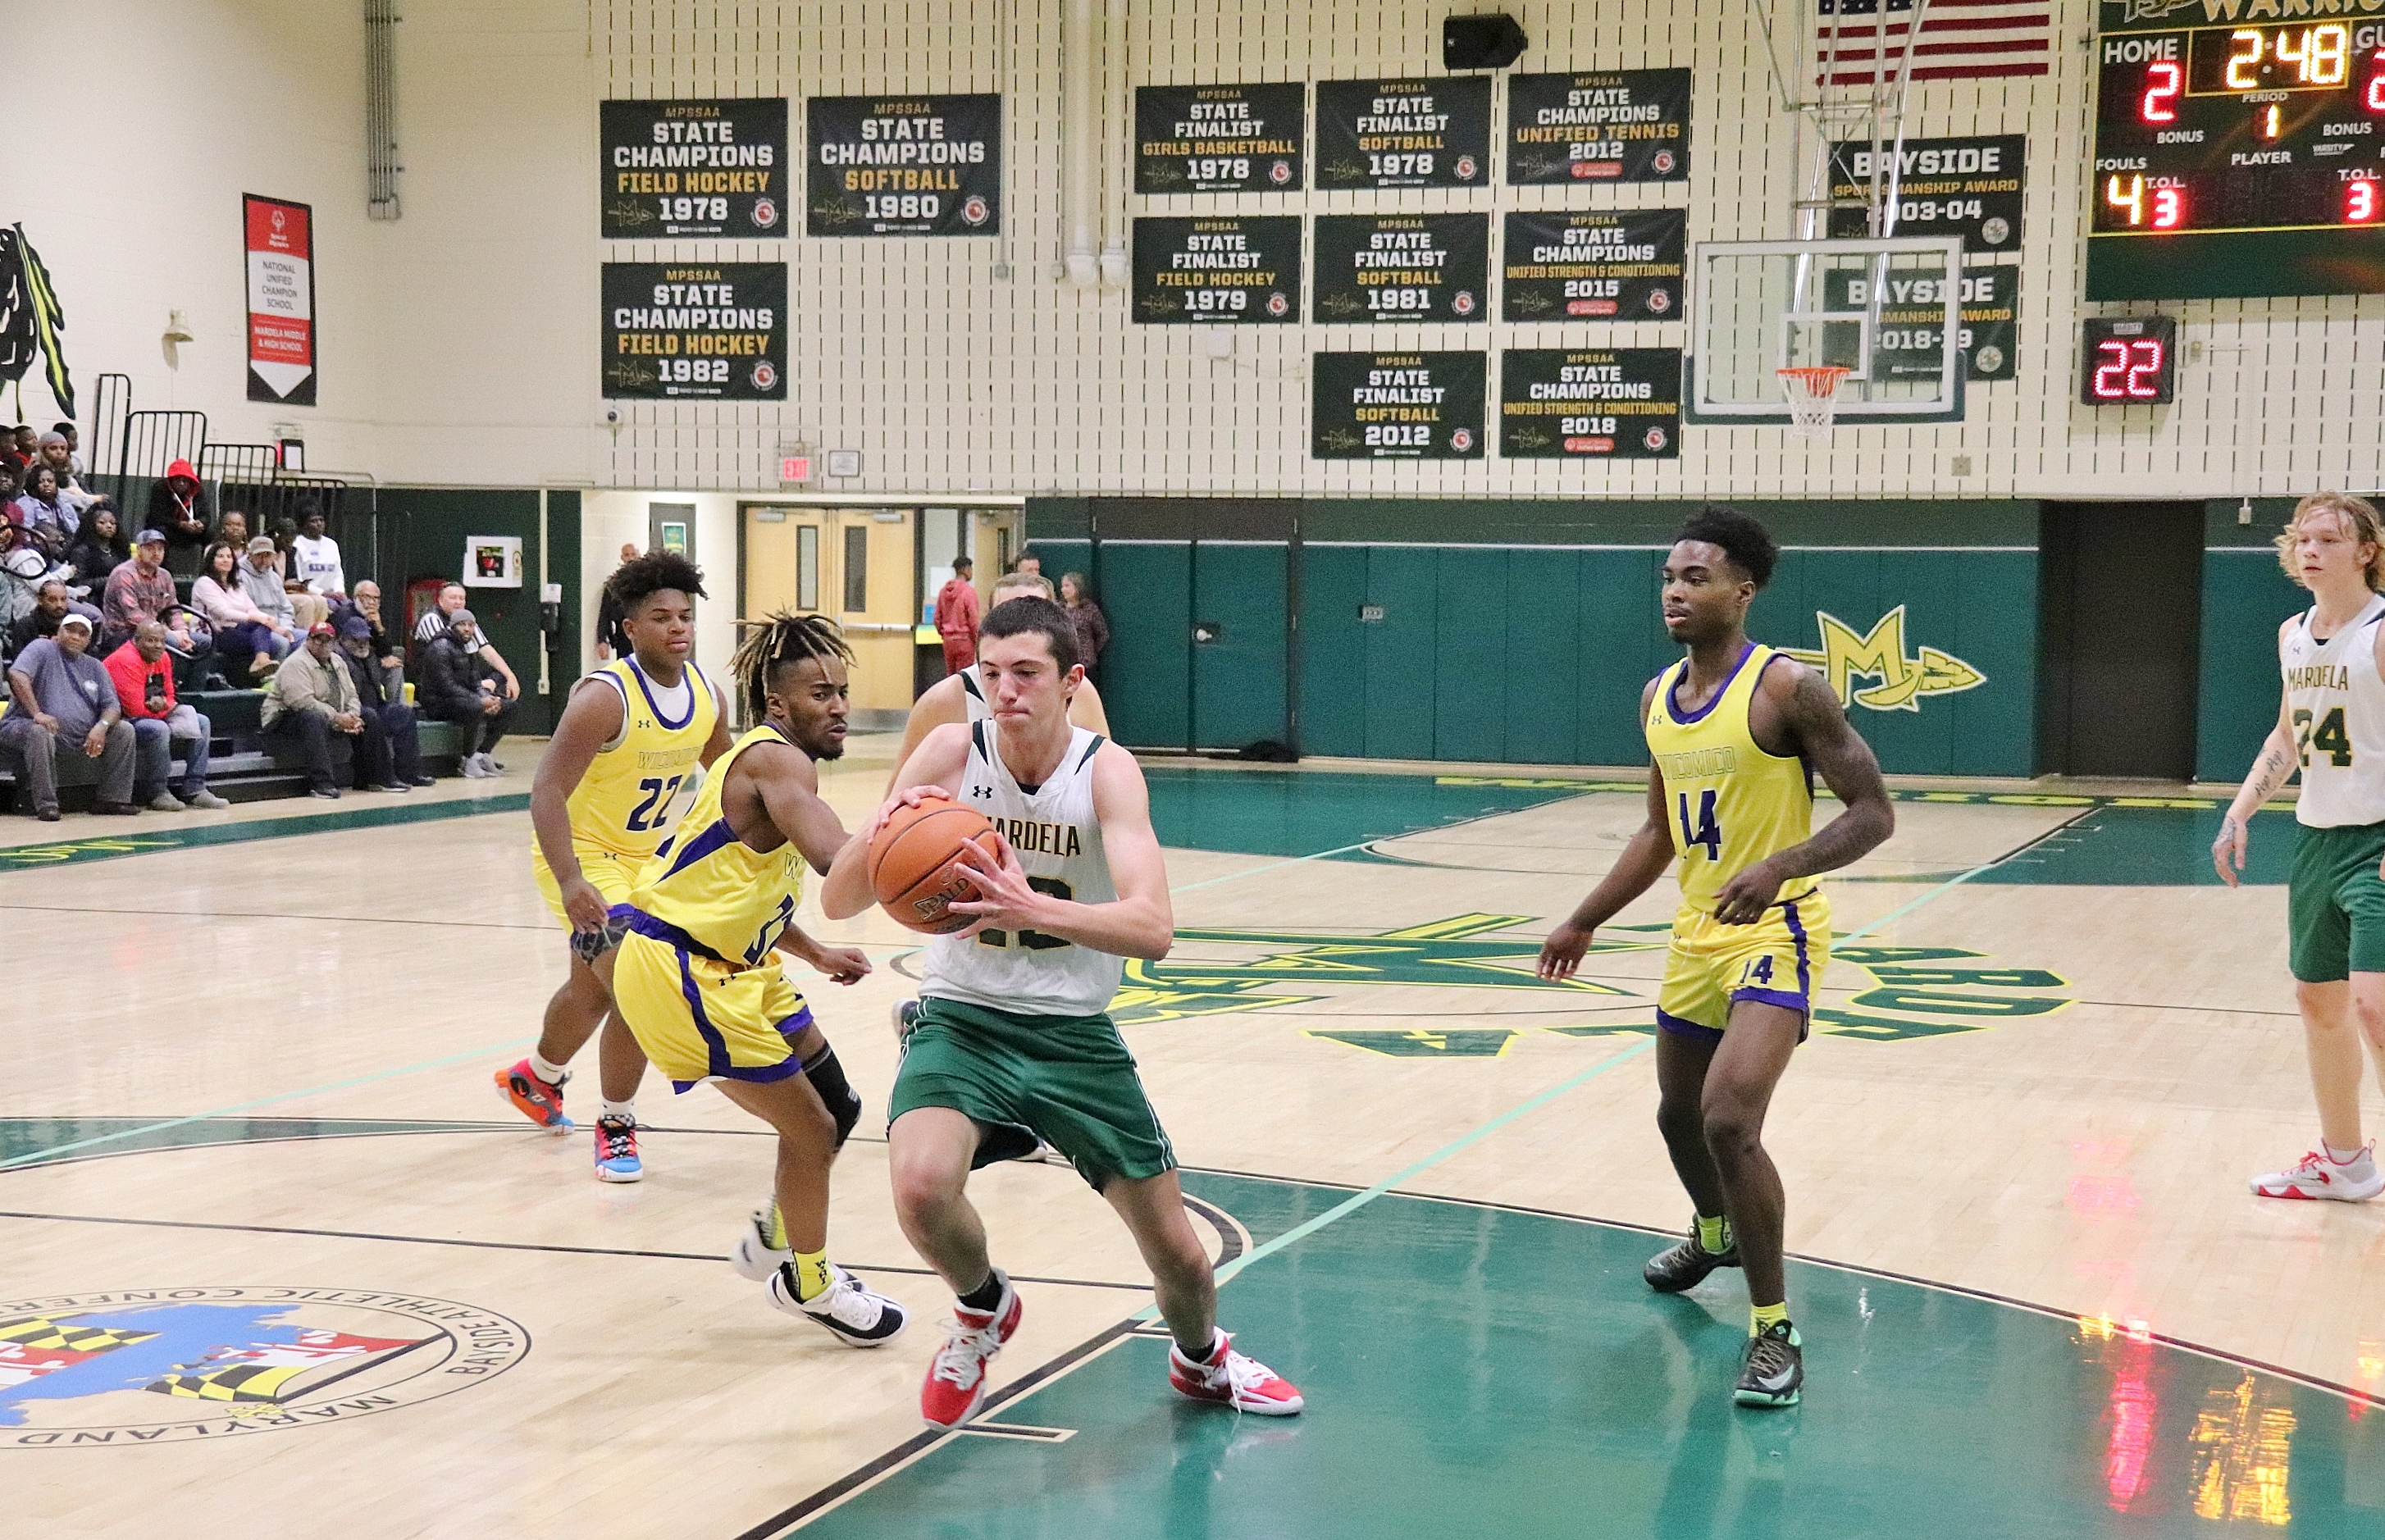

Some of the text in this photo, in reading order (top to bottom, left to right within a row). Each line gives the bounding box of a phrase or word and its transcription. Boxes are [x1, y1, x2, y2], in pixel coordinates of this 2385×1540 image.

[2105, 39, 2178, 63] HOME
[2226, 23, 2347, 89] 2:48
[1379, 84, 1426, 93] MPSSAA
[1575, 77, 1622, 87] MPSSAA
[1197, 90, 1241, 99] MPSSAA
[1568, 89, 1630, 107] STATE
[2141, 62, 2182, 122] 2
[2242, 92, 2288, 103] PERIOD
[665, 106, 720, 117] MPSSAA
[874, 103, 931, 115] MPSSAA
[1190, 103, 1249, 120] STATE
[1372, 97, 1433, 114] STATE
[1357, 114, 1448, 134] FINALIST
[1537, 105, 1660, 125] CHAMPIONS
[2265, 104, 2280, 138] 1
[654, 122, 732, 144] STATE
[861, 118, 944, 140] STATE
[1174, 121, 1264, 138] FINALIST
[1517, 123, 1680, 144] UNIFIED TENNIS
[2157, 130, 2205, 144] BONUS
[2323, 122, 2373, 137] BONUS
[1142, 139, 1296, 156] GIRLS BASKETBALL
[1358, 135, 1444, 152] SOFTBALL
[1569, 141, 1624, 160] 2012
[614, 145, 773, 167] CHAMPIONS
[821, 143, 984, 165] CHAMPIONS
[2231, 151, 2292, 166] PLAYER
[1187, 158, 1249, 180] 1978
[1368, 154, 1434, 175] 1978
[2095, 157, 2147, 171] FOULS
[618, 171, 769, 193] FIELD HOCKEY
[845, 169, 959, 191] SOFTBALL
[2145, 176, 2187, 189] T.O.L.
[2337, 168, 2382, 181] T.O.L.
[1834, 180, 2018, 197] SPORSMANSHIP AWARD
[659, 197, 728, 221] 1978
[865, 195, 939, 219] 1980
[2108, 174, 2141, 226] 4
[2154, 189, 2178, 227] 3
[2347, 181, 2373, 221] 3
[1866, 199, 1981, 222] 03-04
[1194, 221, 1239, 231] MPSSAA
[1377, 219, 1425, 229] MPSSAA
[1571, 216, 1618, 226] MPSSAA
[1187, 235, 1246, 251] STATE
[1370, 232, 1431, 249] STATE
[1563, 228, 1625, 244] STATE
[1172, 252, 1261, 270] FINALIST
[1354, 250, 1447, 268] FINALIST
[1533, 244, 1655, 262] CHAMPIONS
[262, 261, 296, 274] NATIONAL
[666, 270, 721, 281] MPSSAA
[1507, 264, 1680, 279] UNIFIED STRENGTH & CONDITIONING
[267, 273, 293, 286] UNIFIED
[1156, 271, 1276, 287] FIELD HOCKEY
[1357, 269, 1442, 285] SOFTBALL
[262, 285, 298, 298] CHAMPION
[654, 285, 732, 306] STATE
[1564, 280, 1619, 298] 2015
[267, 298, 294, 311] SCHOOL
[1183, 289, 1247, 311] 1979
[1367, 289, 1431, 309] 1981
[614, 308, 773, 330] CHAMPIONS
[1959, 308, 2012, 321] AWARD
[618, 334, 769, 355] FIELD HOCKEY
[1375, 356, 1422, 367] MPSSAA
[1566, 354, 1615, 364] MPSSAA
[2095, 340, 2159, 396] 22
[659, 359, 728, 382] 1982
[1369, 371, 1430, 386] STATE
[1560, 366, 1621, 382] STATE
[1353, 387, 1444, 404] FINALIST
[1530, 382, 1652, 399] CHAMPIONS
[1356, 408, 1440, 422] SOFTBALL
[1503, 402, 1676, 415] UNIFIED STRENGTH & CONDITIONING
[1561, 417, 1617, 435] 2018
[1365, 426, 1430, 446] 2012
[784, 458, 809, 479] EXIT
[2288, 665, 2349, 691] MARDELA
[2294, 708, 2351, 767] 24
[626, 775, 682, 831] 22
[987, 816, 1081, 857] ARDELA
[912, 877, 970, 921] SPALD
[1740, 955, 1773, 985] 14
[0, 1289, 514, 1375] BAYSIDE ATHLETIC CONFER
[17, 1395, 397, 1445] MARYLAND
